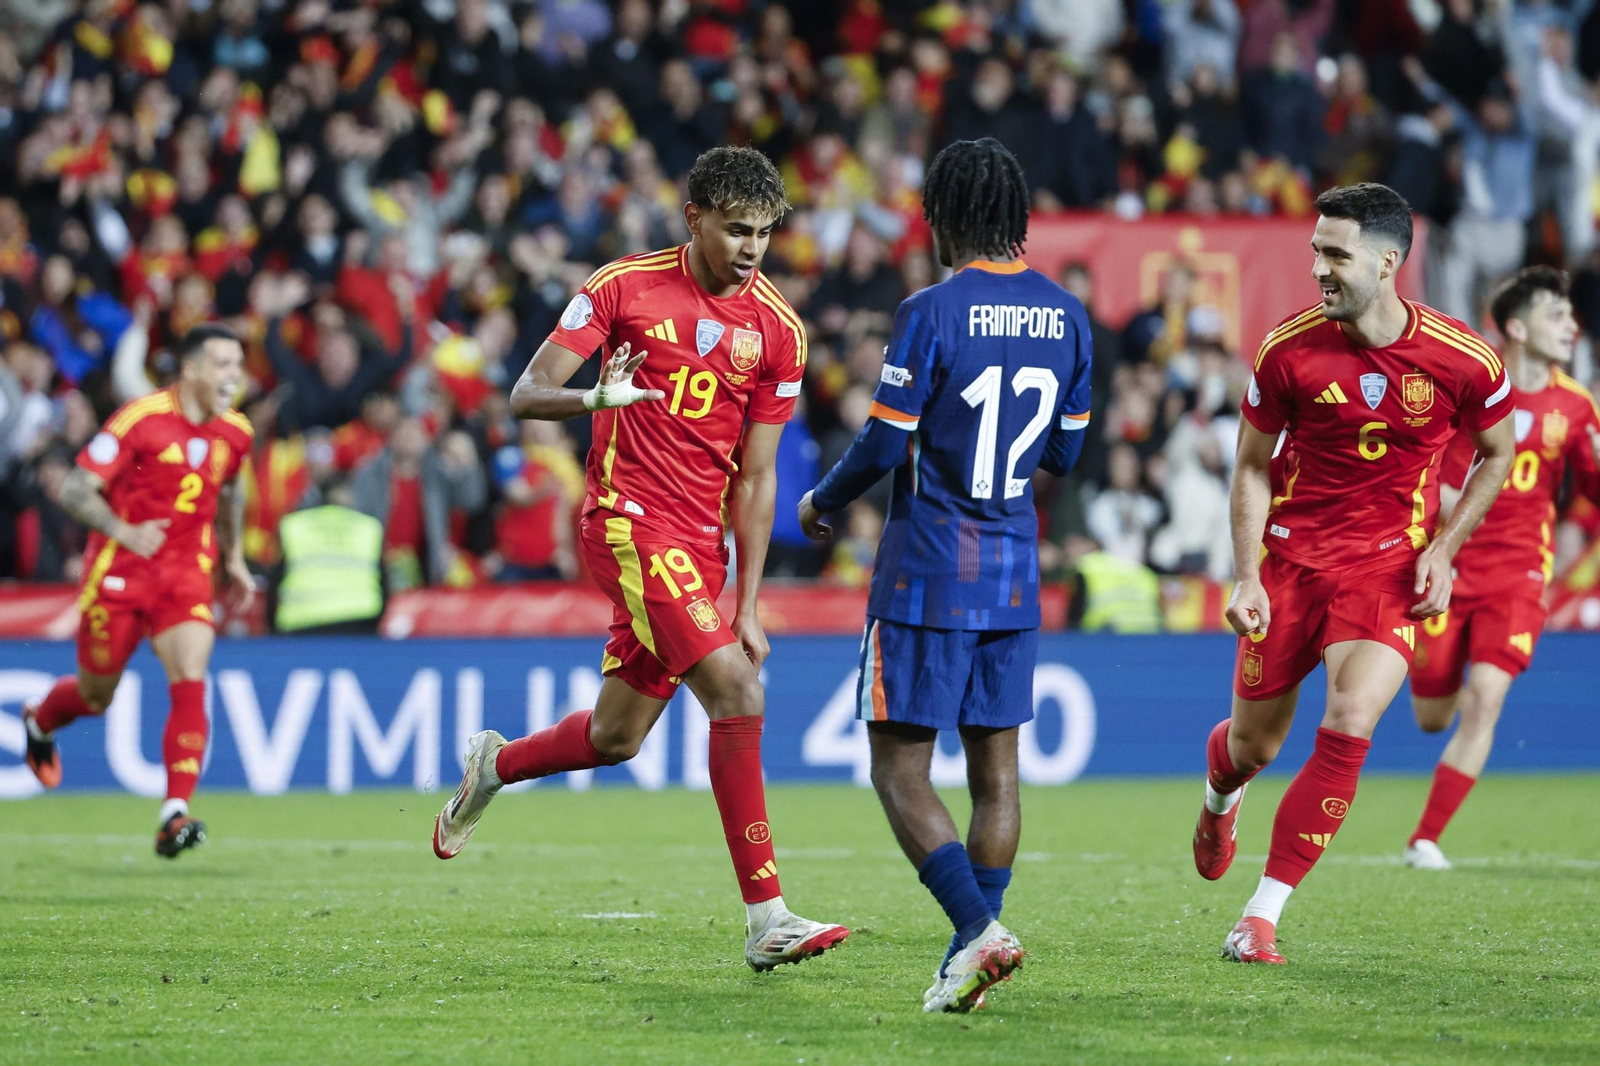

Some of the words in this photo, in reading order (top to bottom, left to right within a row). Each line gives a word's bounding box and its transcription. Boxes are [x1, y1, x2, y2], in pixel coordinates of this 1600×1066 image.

[969, 304, 1065, 340] FRIMPONG
[668, 364, 719, 420] 19
[959, 365, 1060, 500] 12
[1357, 421, 1388, 461] 6
[173, 472, 204, 514] 2
[1502, 449, 1540, 493] 0
[648, 547, 703, 600] 19
[88, 604, 110, 640] 2
[802, 662, 1097, 788] 40
